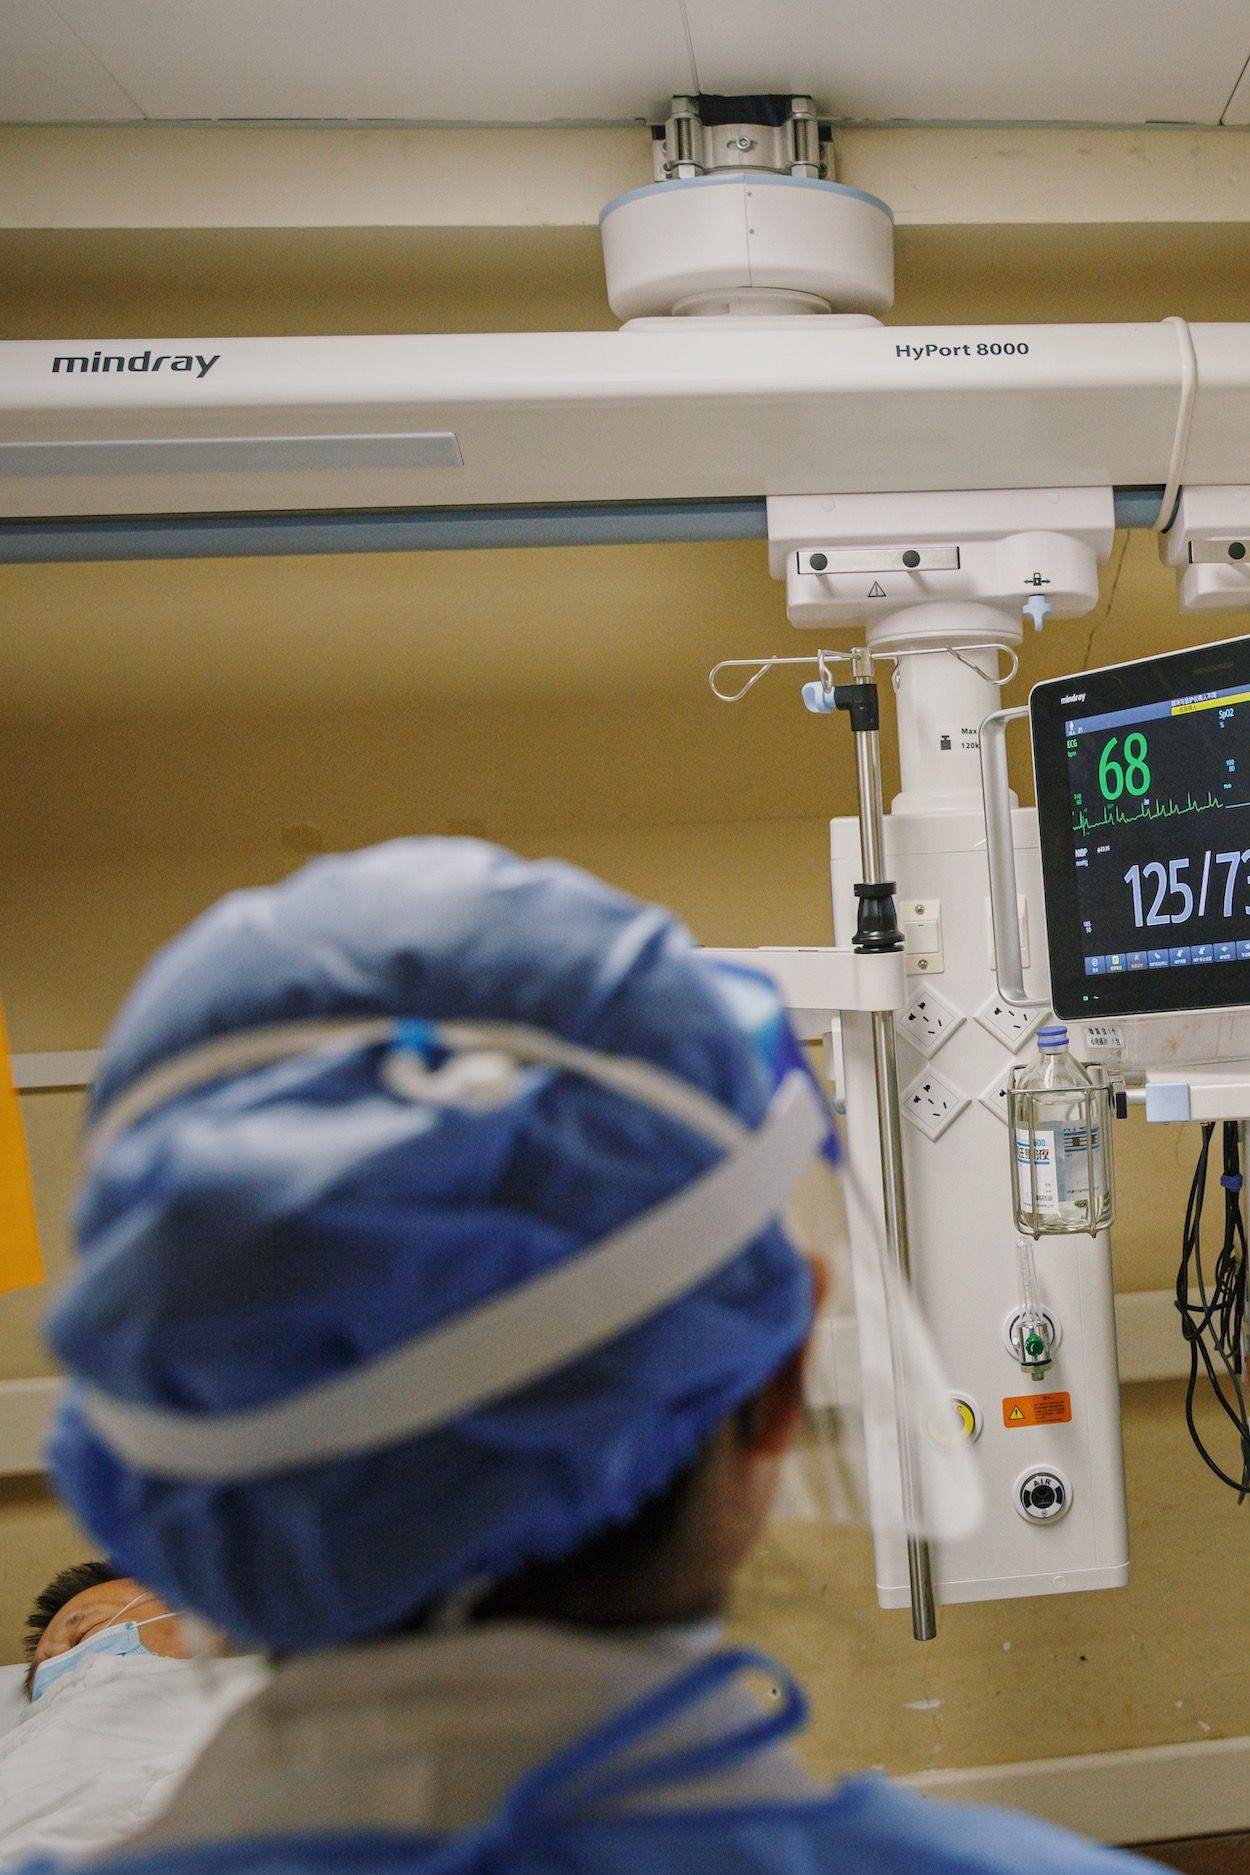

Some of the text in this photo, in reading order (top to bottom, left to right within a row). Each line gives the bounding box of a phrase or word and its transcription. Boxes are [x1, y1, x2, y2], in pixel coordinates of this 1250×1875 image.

[895, 342, 1029, 361] HyPort 8000
[52, 350, 221, 379] mindray
[961, 742, 981, 750] 120k
[1066, 738, 1078, 749] ECG
[1098, 732, 1151, 801] 68
[1033, 1478, 1052, 1488] AIR
